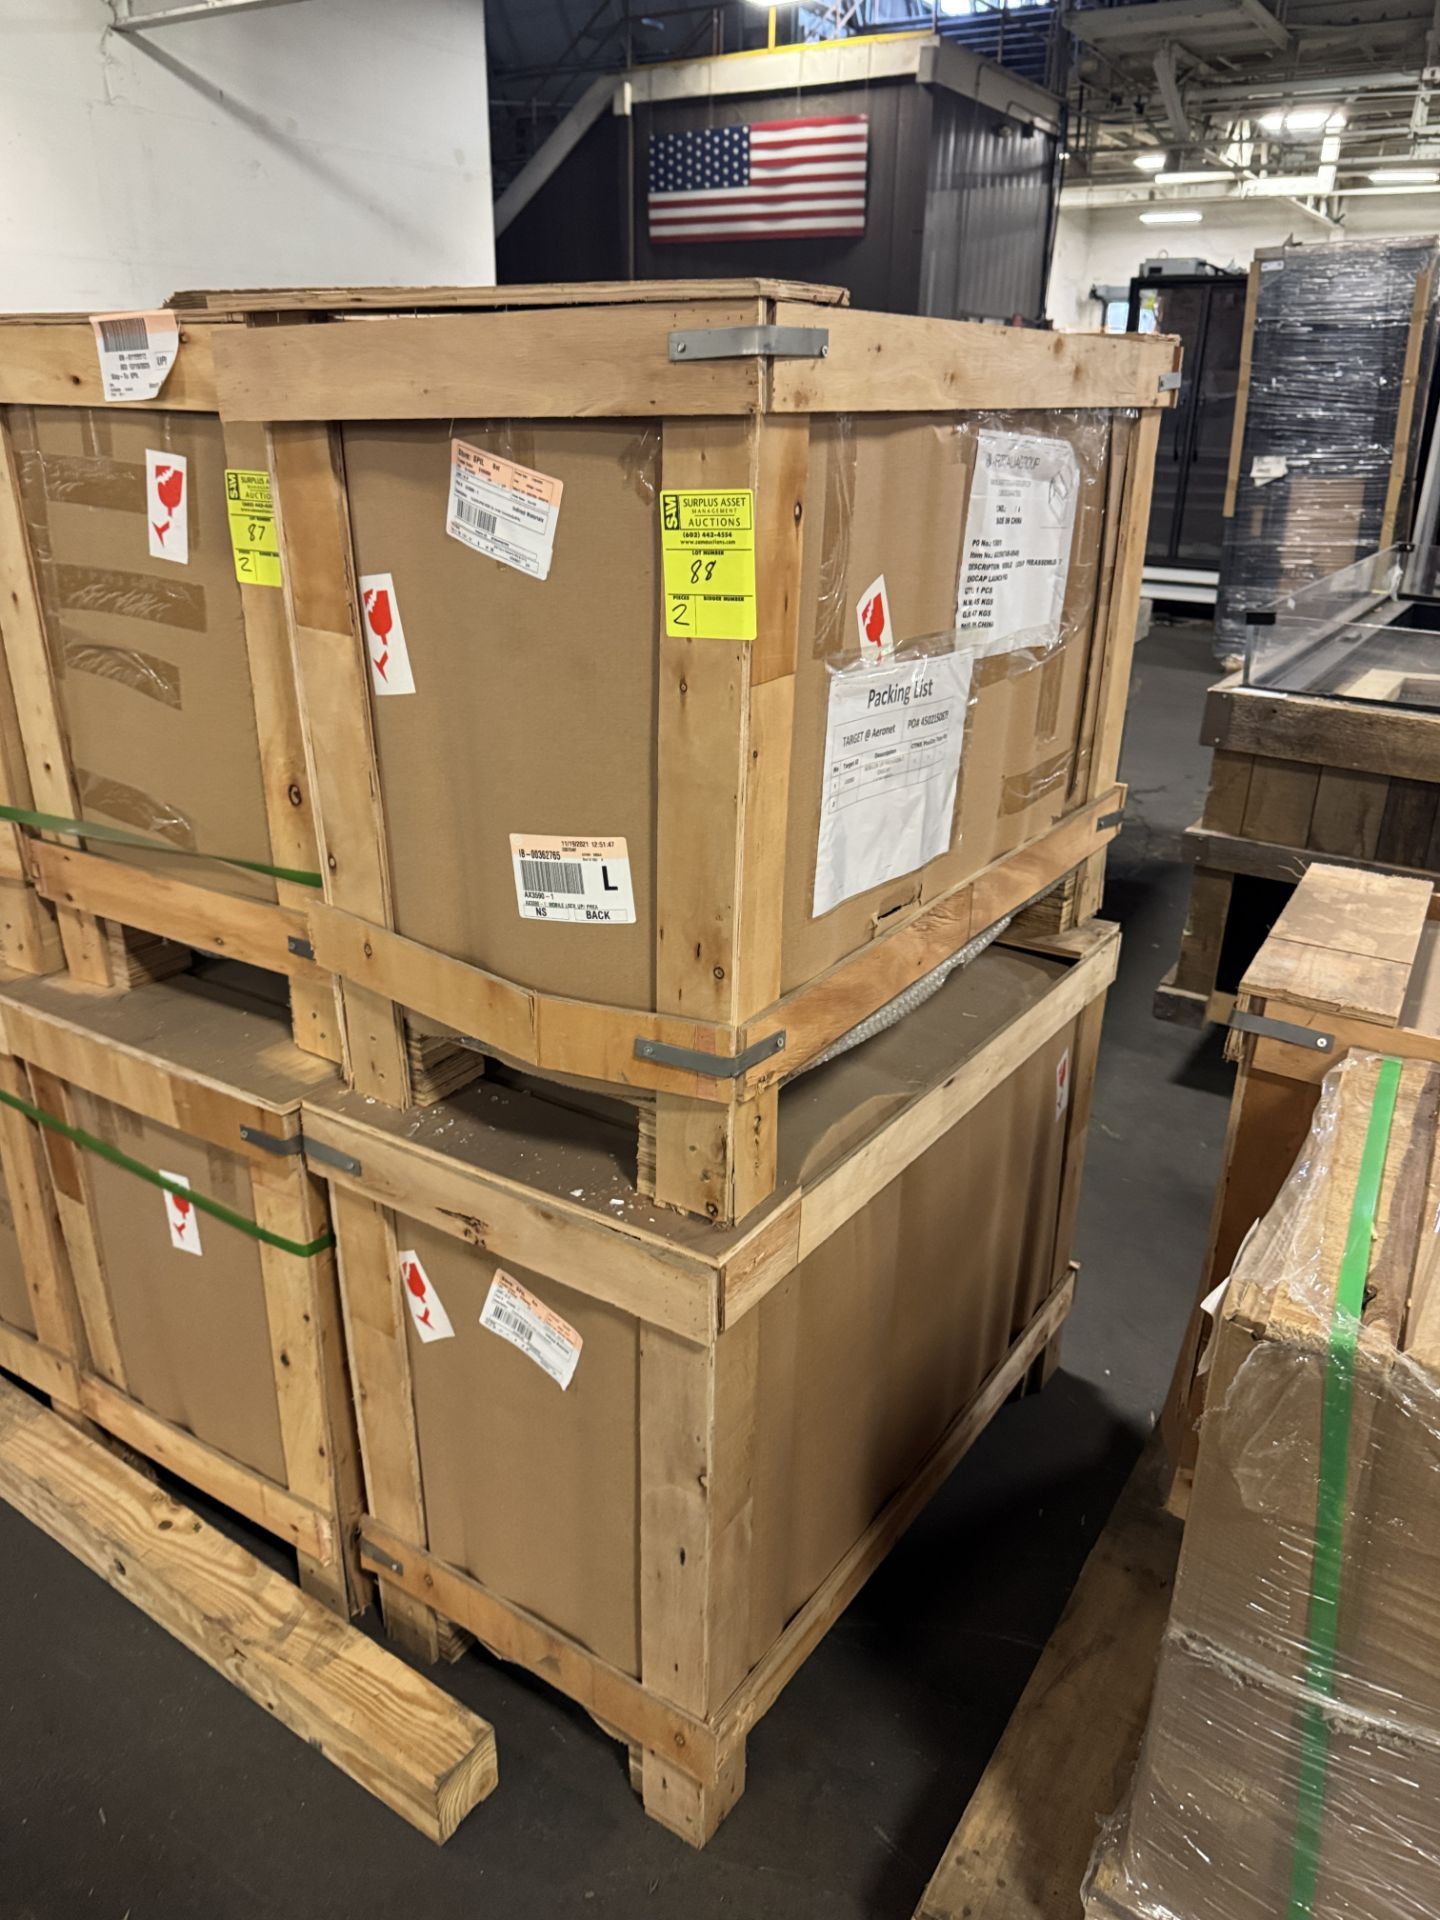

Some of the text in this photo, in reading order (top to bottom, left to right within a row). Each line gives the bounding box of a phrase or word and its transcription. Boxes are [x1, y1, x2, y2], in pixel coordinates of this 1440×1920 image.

[683, 497, 746, 507] SURPLUS ASSET
[664, 496, 679, 529] SAM
[688, 518, 741, 527] AUCTIONS
[248, 523, 266, 541] 87
[239, 557, 252, 572] 2
[690, 560, 717, 584] 88
[672, 604, 690, 626] 2
[867, 678, 934, 709] Packing List
[843, 731, 864, 748] TARGET
[871, 723, 897, 738] Aeronet
[601, 865, 619, 891] L
[535, 907, 548, 917] NS
[585, 910, 611, 920] BACK
